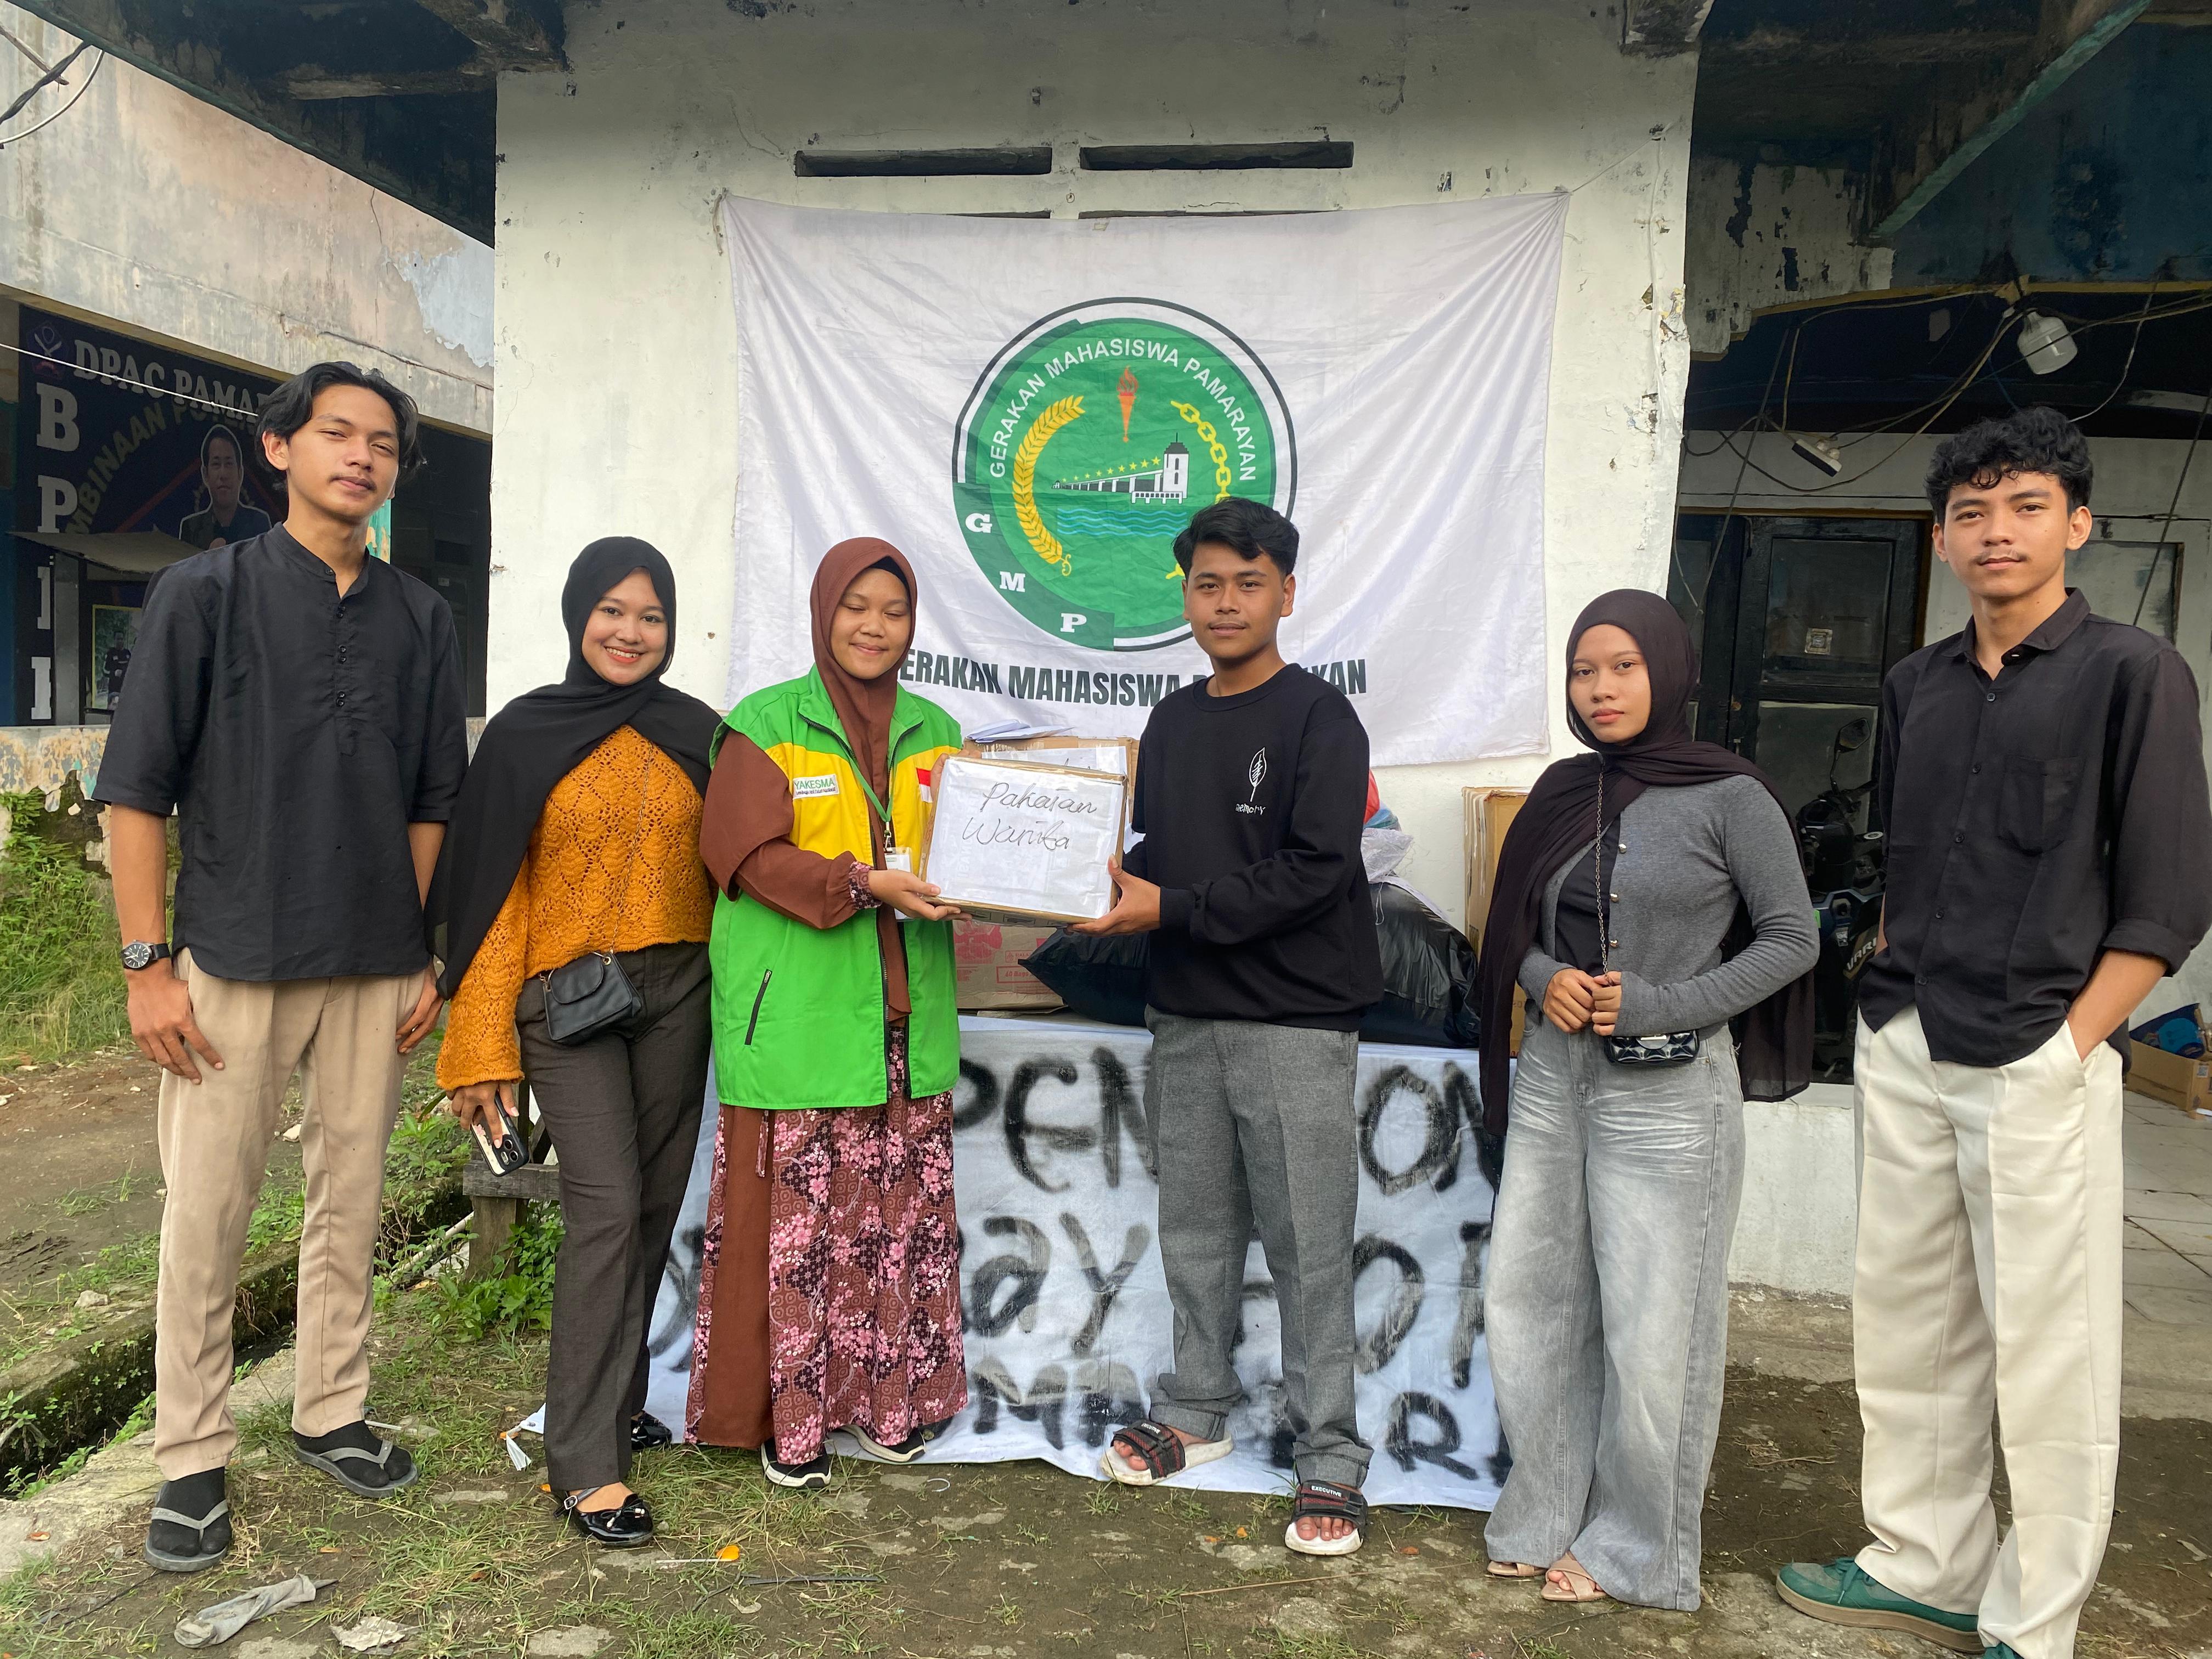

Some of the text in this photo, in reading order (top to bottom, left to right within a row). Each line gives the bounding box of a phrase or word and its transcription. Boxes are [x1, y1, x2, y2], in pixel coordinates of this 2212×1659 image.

[74, 339, 166, 399] DPAC
[989, 338, 1257, 482] GERAKAN MAHASISWA PAMARAYAN
[964, 512, 1087, 633] G M P
[900, 648, 1003, 695] ERAKAN
[1008, 664, 1180, 707] MAHASISWA
[794, 778, 835, 789] YAKESMA
[979, 782, 1097, 813] Pakaian
[962, 816, 1070, 851] Wanita
[1846, 937, 1877, 970] VARI
[1311, 1485, 1342, 1497] EXECUTIVE
